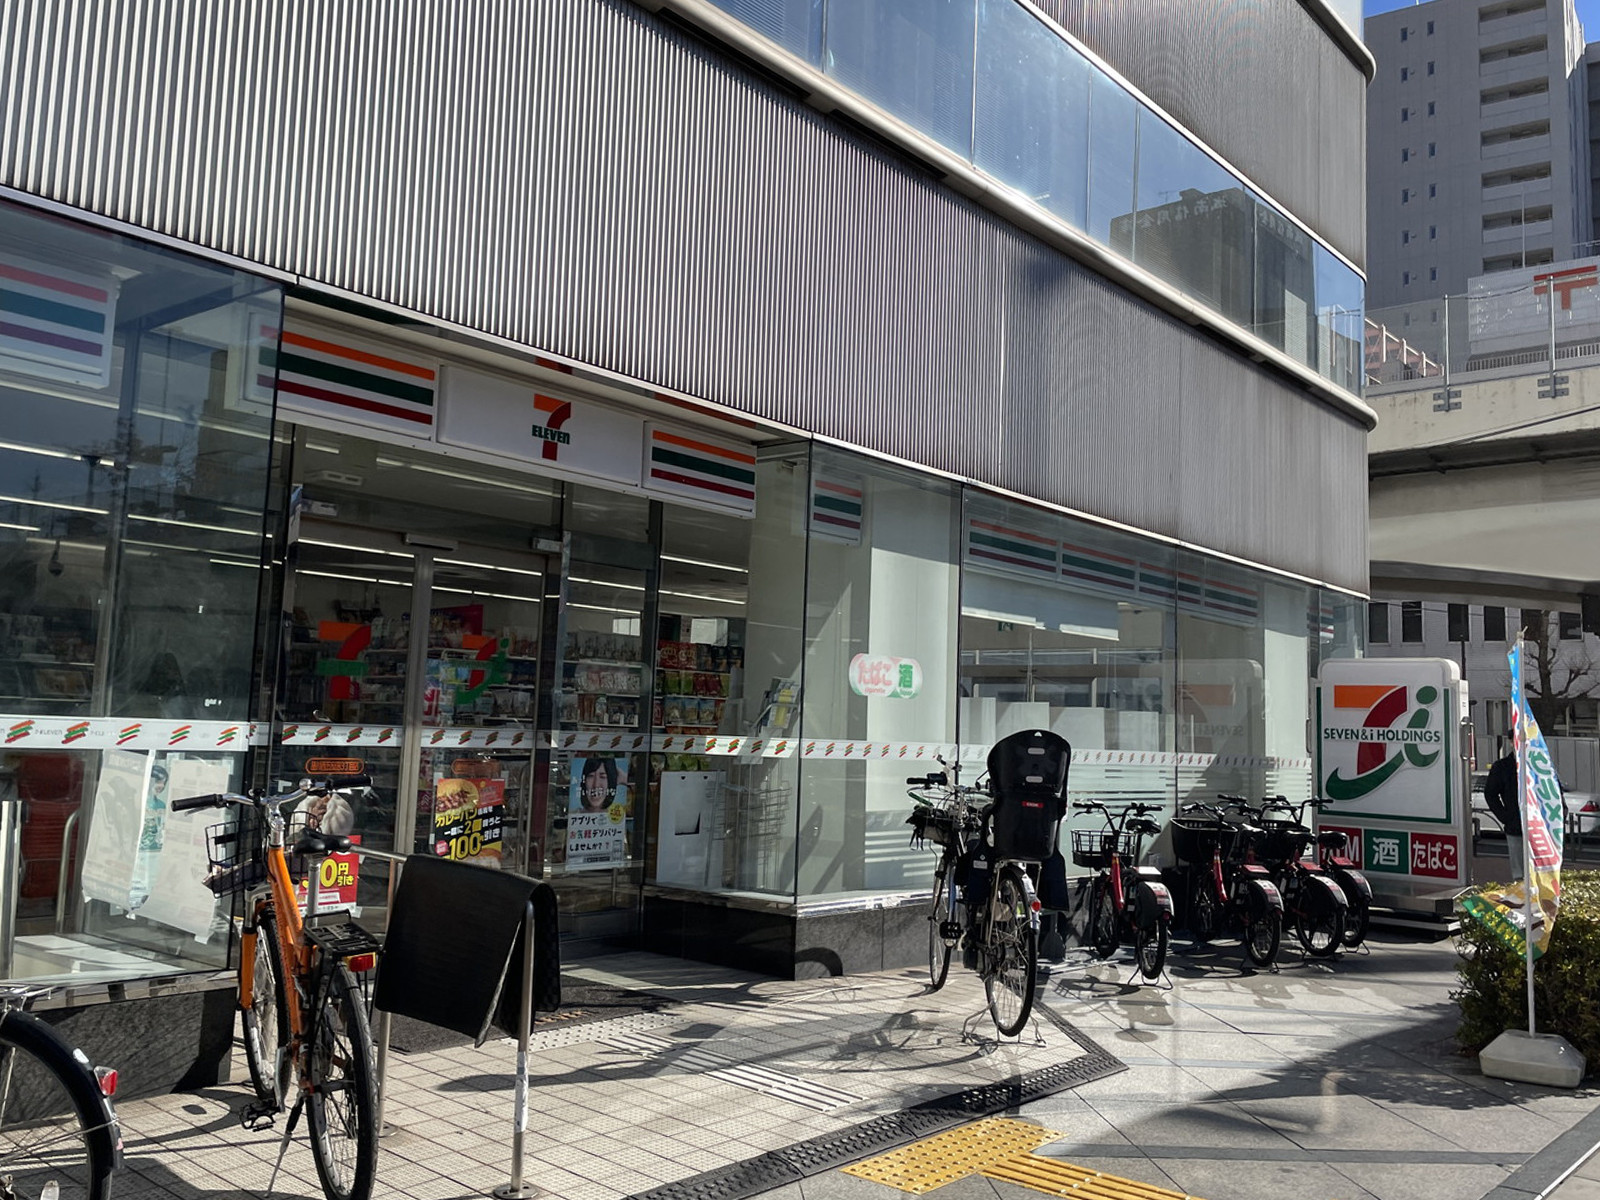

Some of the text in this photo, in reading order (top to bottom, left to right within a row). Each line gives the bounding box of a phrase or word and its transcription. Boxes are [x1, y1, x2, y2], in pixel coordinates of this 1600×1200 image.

[1377, 729, 1441, 743] HOLDINGS
[571, 815, 598, 826] アプリで
[1373, 836, 1457, 871] 酒 たばこ
